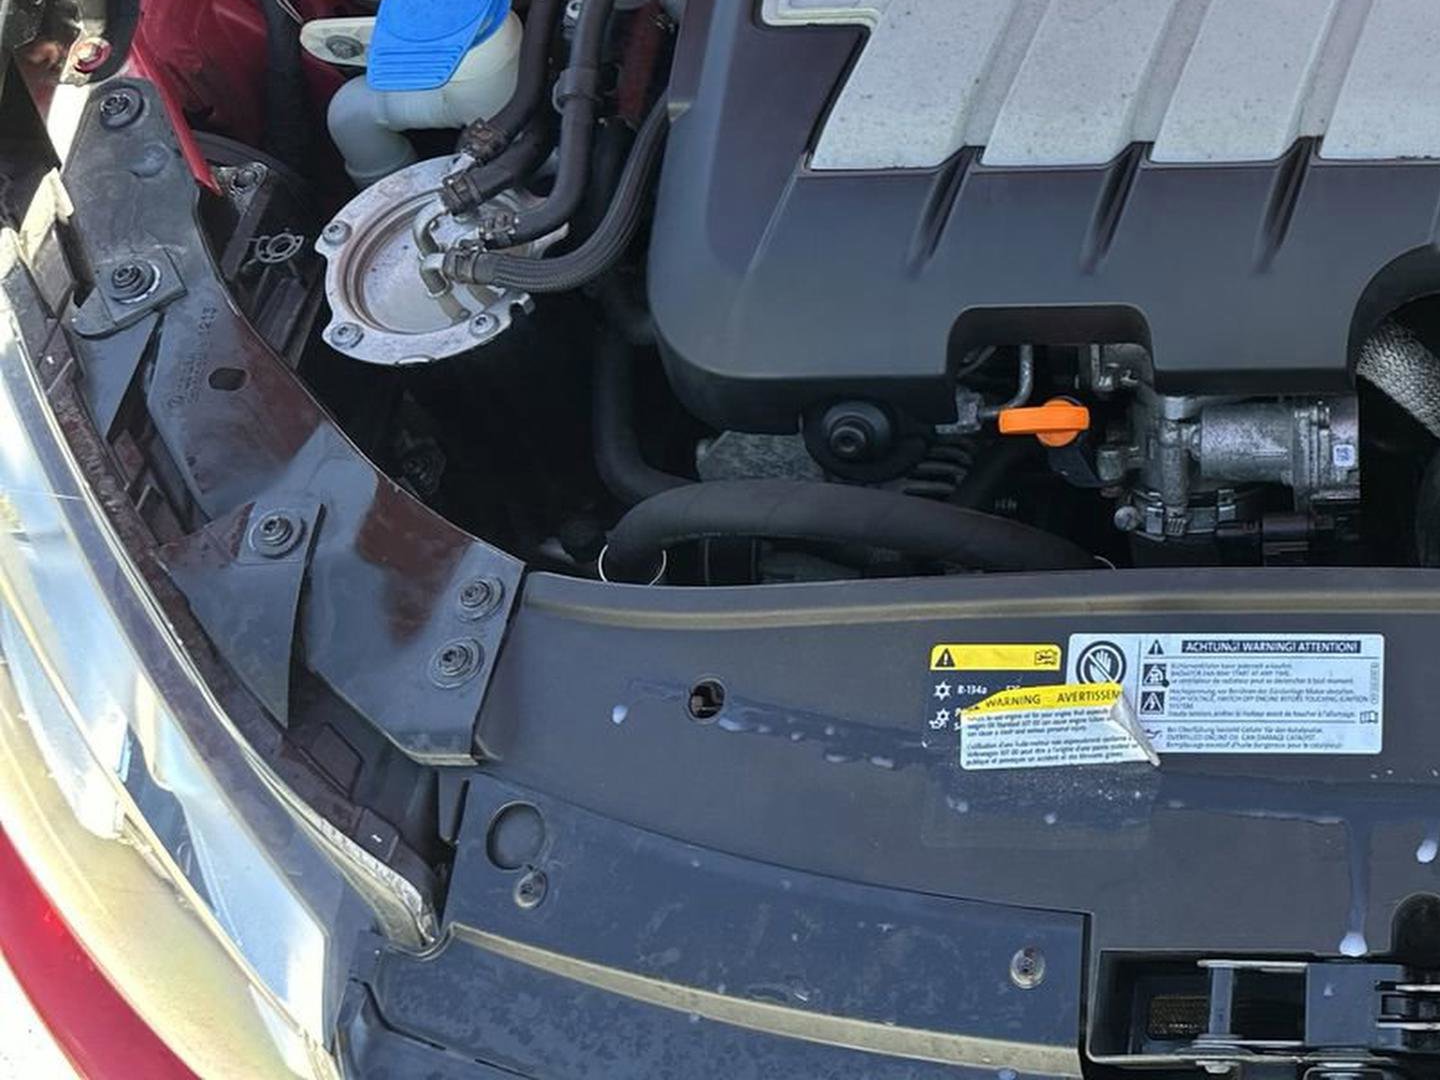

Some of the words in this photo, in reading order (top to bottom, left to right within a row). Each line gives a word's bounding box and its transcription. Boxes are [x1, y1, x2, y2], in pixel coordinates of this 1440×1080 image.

[1185, 640, 1241, 652] ACHTUNG!
[1242, 640, 1297, 652] WARNING!
[1299, 640, 1358, 652] ATTENTION!
[985, 694, 1041, 708] WARNING
